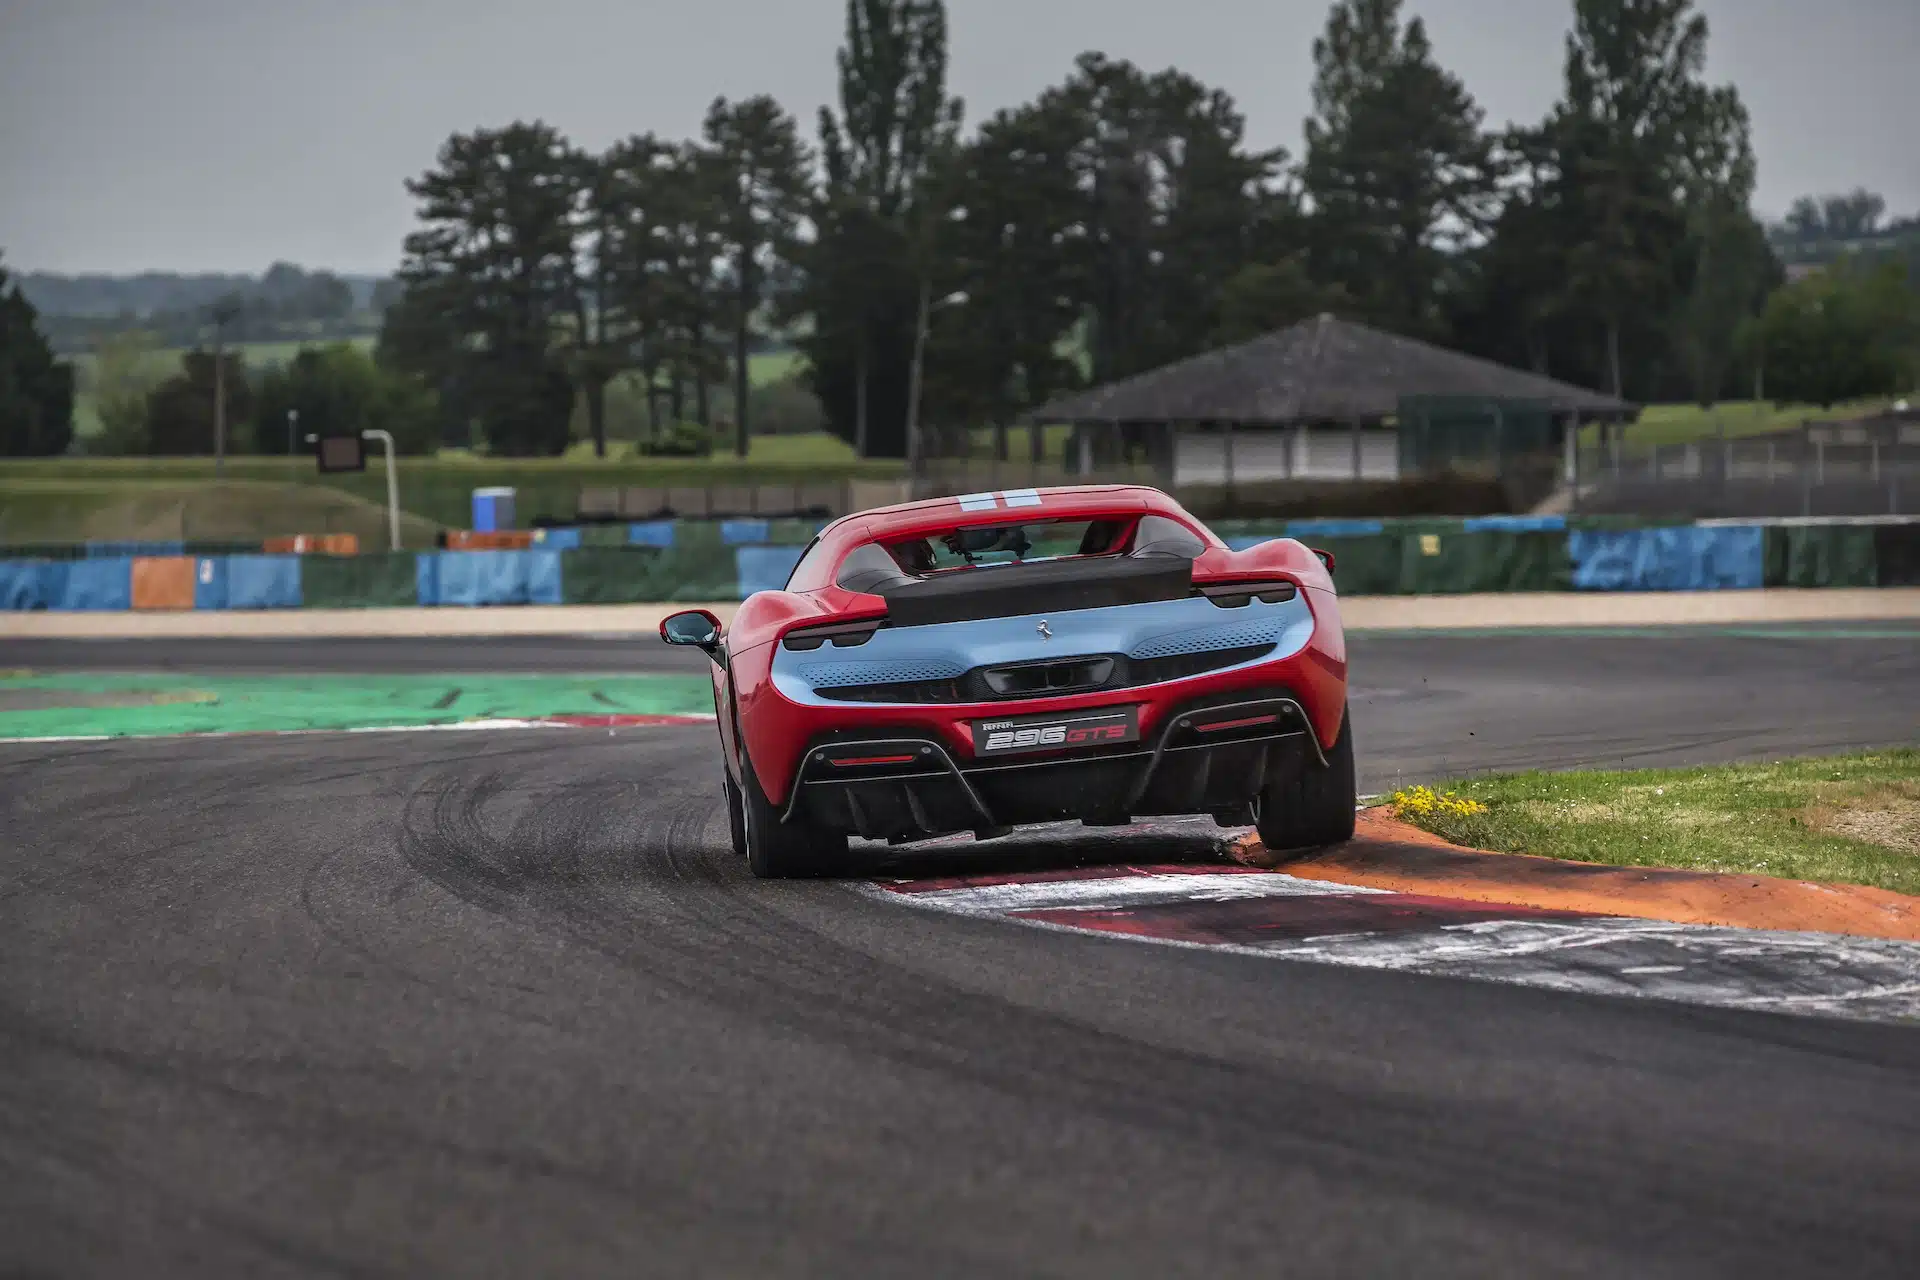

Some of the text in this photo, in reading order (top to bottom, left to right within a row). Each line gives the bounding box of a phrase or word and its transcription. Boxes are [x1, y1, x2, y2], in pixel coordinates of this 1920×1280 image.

[982, 721, 1014, 731] Ferrari
[985, 724, 1128, 750] 296 GTS
